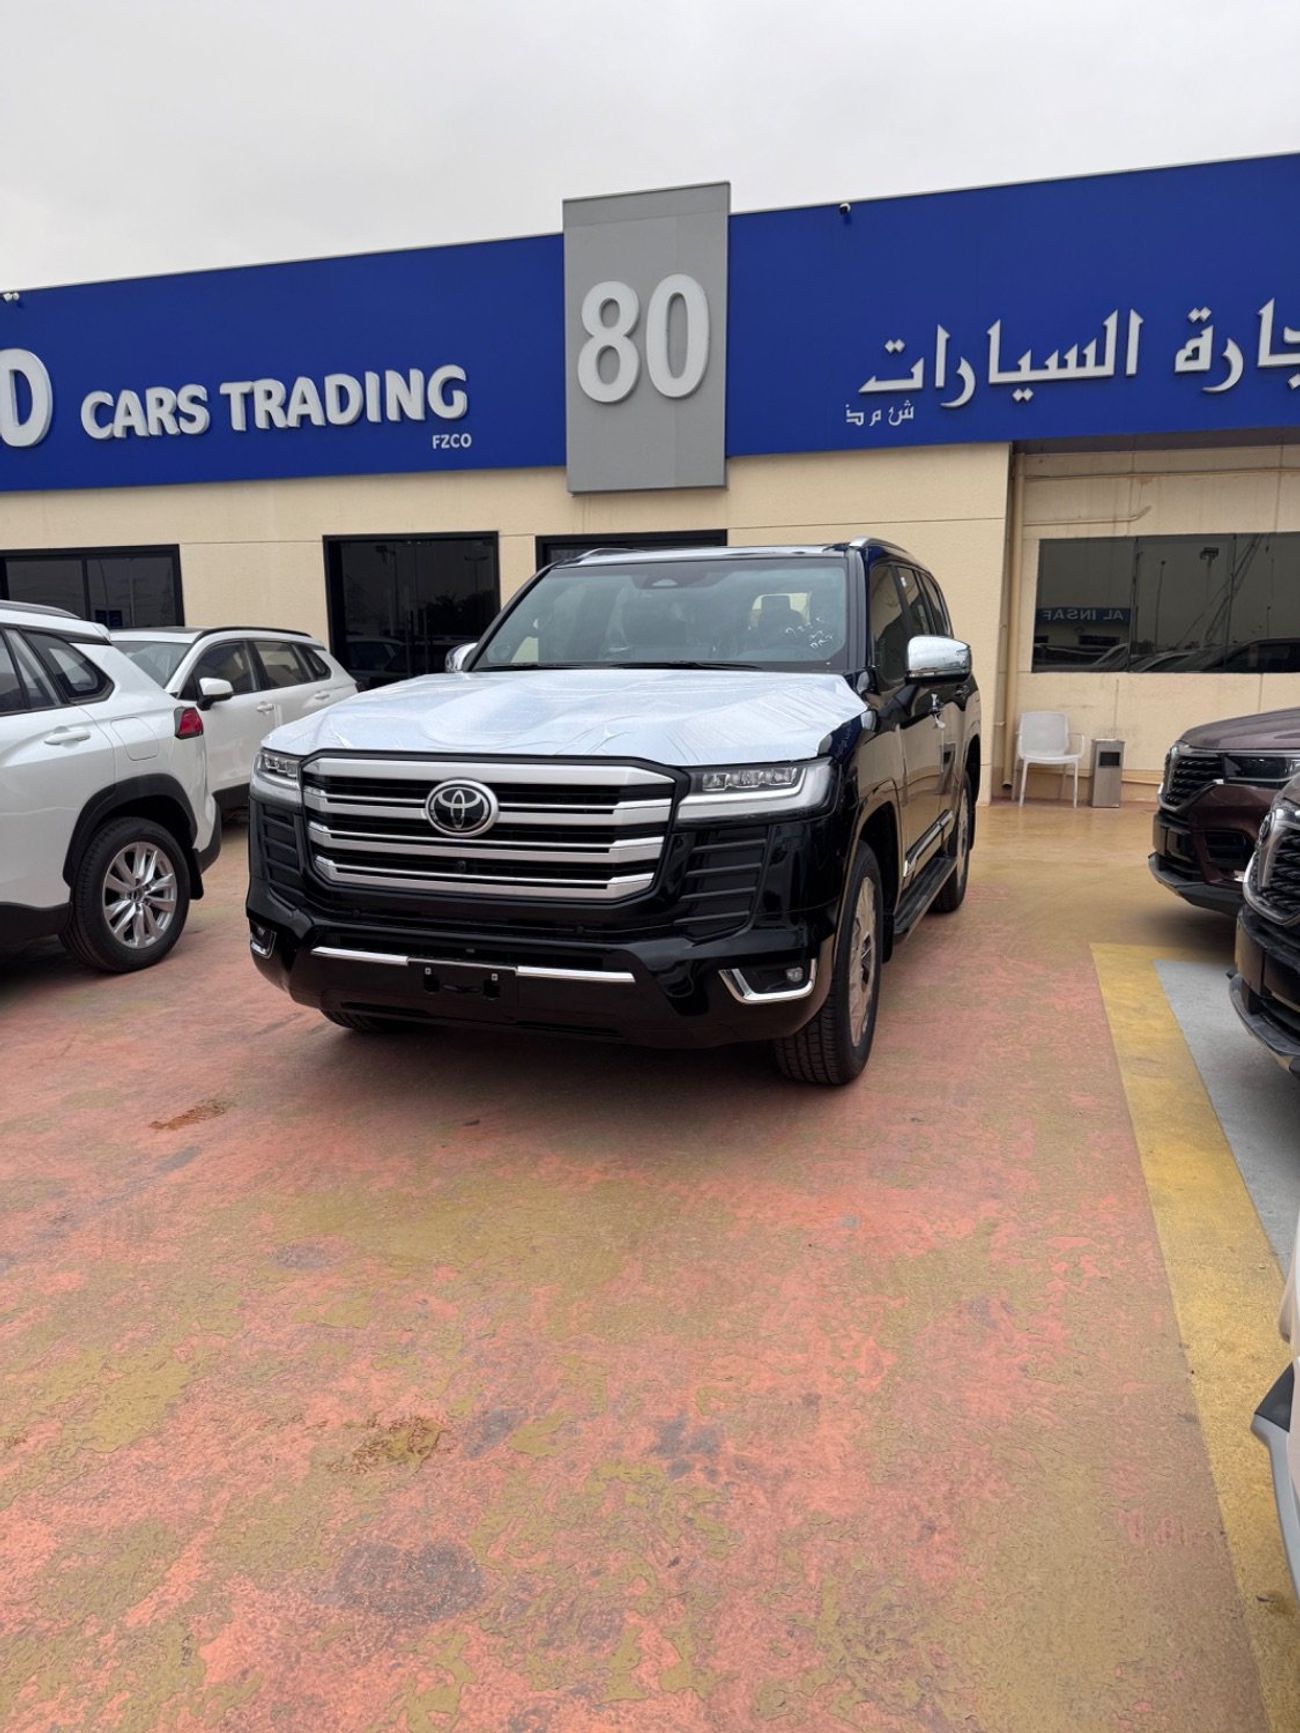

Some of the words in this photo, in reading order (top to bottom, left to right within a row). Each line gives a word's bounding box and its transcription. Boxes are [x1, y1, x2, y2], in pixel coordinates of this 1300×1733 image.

[577, 273, 710, 403] 80
[858, 308, 1144, 408] السيارات
[81, 384, 210, 439] CARS
[219, 364, 468, 431] TRADING
[869, 409, 881, 427] م
[888, 400, 914, 426] ش
[432, 433, 472, 449] FZCO
